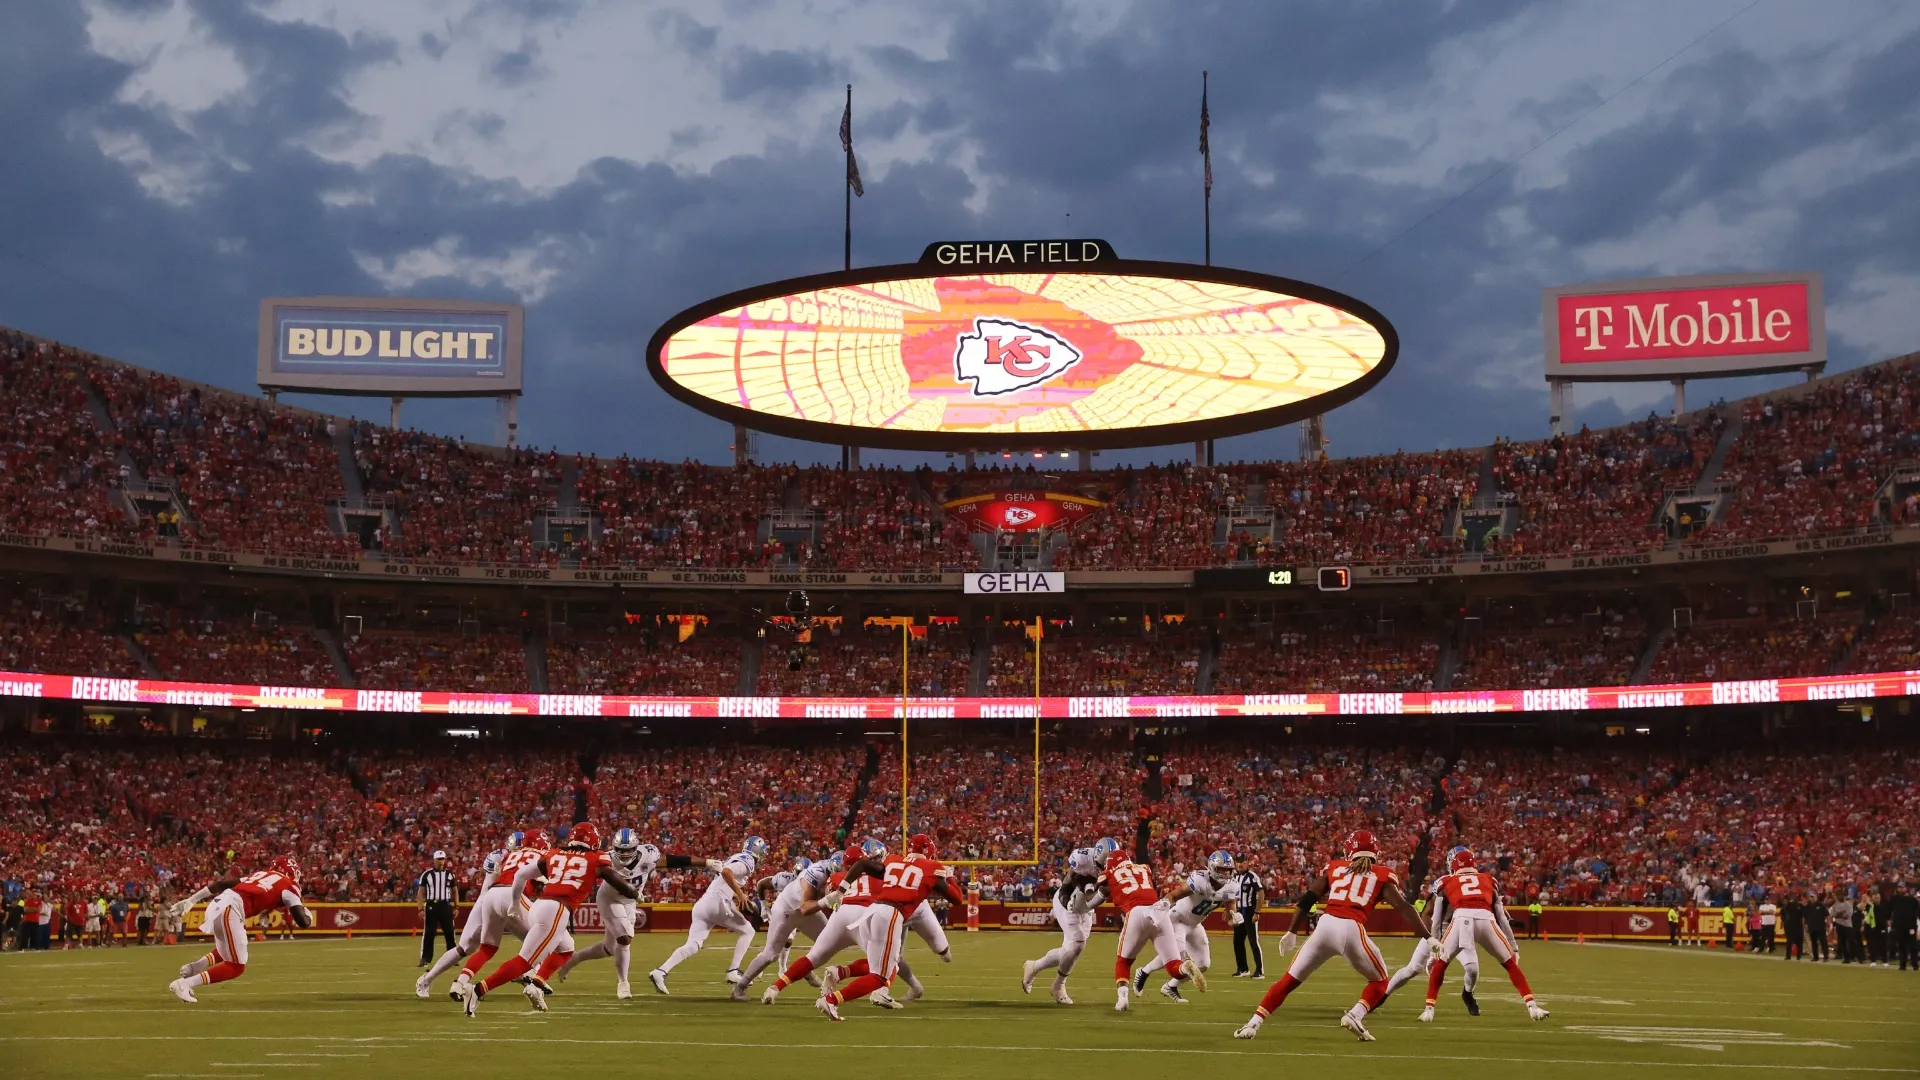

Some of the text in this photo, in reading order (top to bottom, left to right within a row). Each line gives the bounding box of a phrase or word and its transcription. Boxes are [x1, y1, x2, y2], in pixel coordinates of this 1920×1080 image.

[936, 242, 1100, 265] GEHA FIELD
[1623, 298, 1791, 349] Mobile
[288, 328, 493, 360] BUD LIGHT
[984, 335, 1050, 378] KC
[1005, 493, 1036, 502] GEHA
[958, 503, 977, 513] GEHA
[1063, 502, 1083, 511] GEHA
[1827, 533, 1893, 549] HEADRICK
[100, 543, 153, 557] DAWSON
[1701, 544, 1768, 559] STENERUD
[208, 552, 237, 564] BELL
[1587, 558, 1599, 567] A.
[1602, 555, 1651, 567] HAYNES
[292, 559, 359, 572] BUCHANAN
[414, 566, 460, 577] TAYLOR
[1395, 565, 1454, 576] PODOLAK
[1506, 561, 1546, 571] LYNCH
[509, 570, 551, 580] BUDDE
[589, 571, 601, 580] W.
[605, 572, 648, 581] LANIER
[697, 574, 746, 583] THOMAS
[769, 574, 846, 583] HANK STRAM
[885, 574, 895, 583] J.
[898, 574, 942, 583] WILSON
[1268, 571, 1291, 584] 4:20
[1336, 570, 1347, 586] 7
[977, 572, 1051, 593] GEHA
[71, 676, 139, 702] DEFENSE
[356, 690, 422, 713] DEFENSE
[538, 694, 602, 717] DEFENSE
[718, 697, 780, 718] DEFENSE
[1068, 696, 1130, 718] DEFENSE
[1339, 693, 1403, 714] DEFENSE
[1523, 688, 1589, 712] DEFENSE
[1711, 680, 1780, 705] DEFENSE
[548, 854, 588, 890] 32
[882, 862, 924, 891] 50
[1113, 866, 1154, 895] 97
[1329, 866, 1378, 907] 20
[1459, 875, 1482, 896] 2
